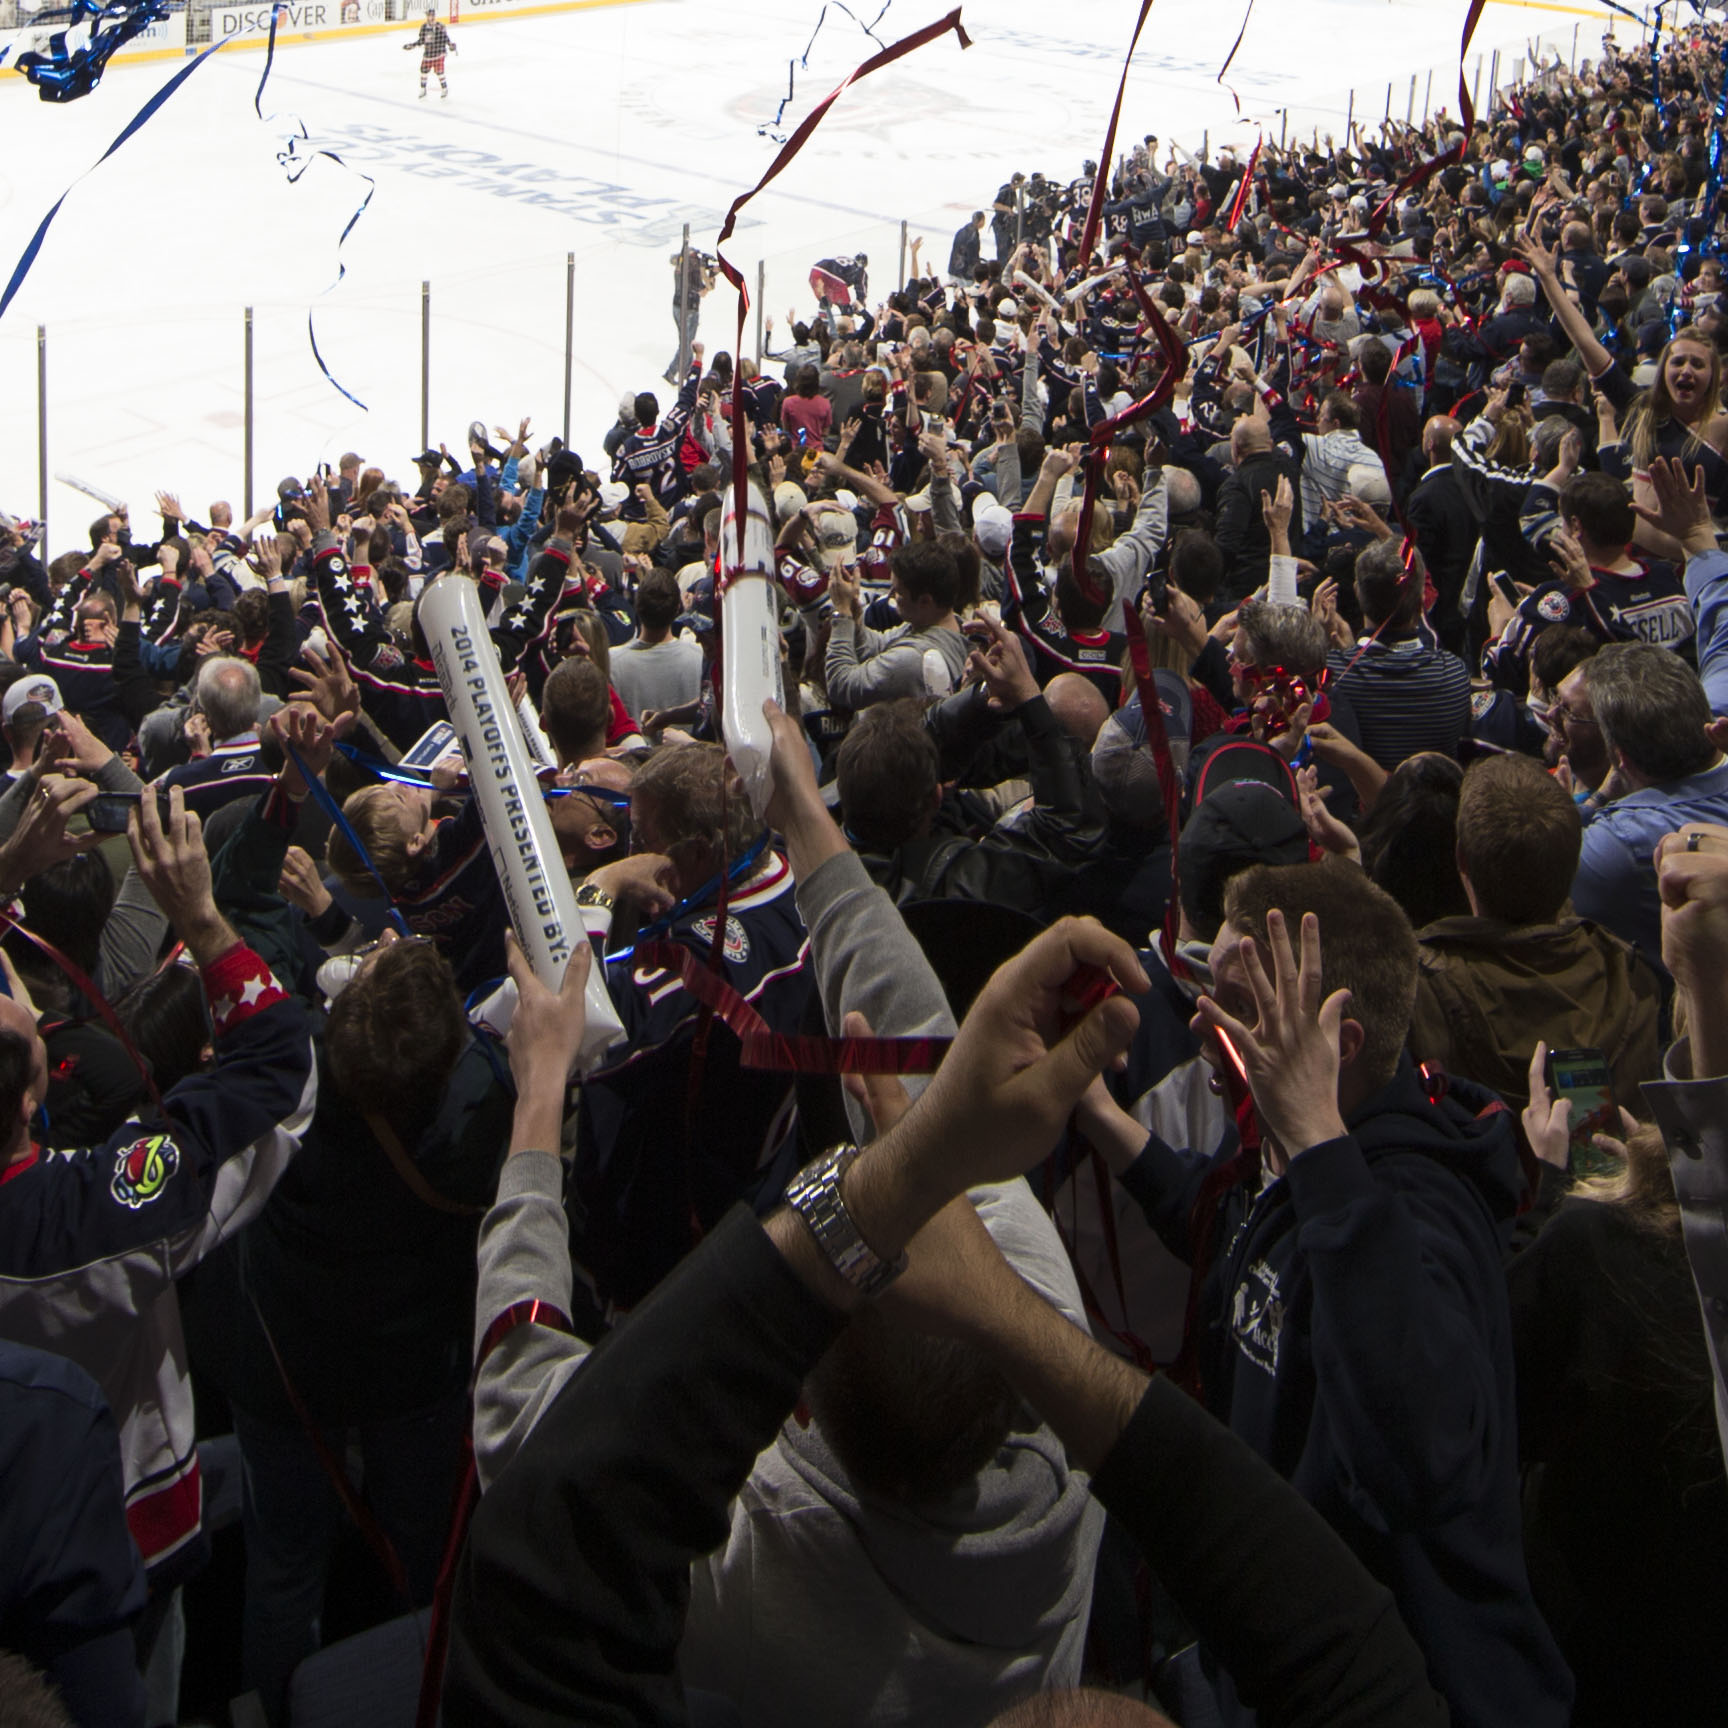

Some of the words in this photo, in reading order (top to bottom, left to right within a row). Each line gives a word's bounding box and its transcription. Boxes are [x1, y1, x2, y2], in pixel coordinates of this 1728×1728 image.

[223, 4, 327, 35] DISCOVER
[628, 443, 676, 470] BOBROVSKY
[452, 625, 478, 672] 2014
[466, 675, 512, 780] PLAYOFFS
[500, 783, 553, 921] PRESENTED
[543, 920, 571, 964] BY:
